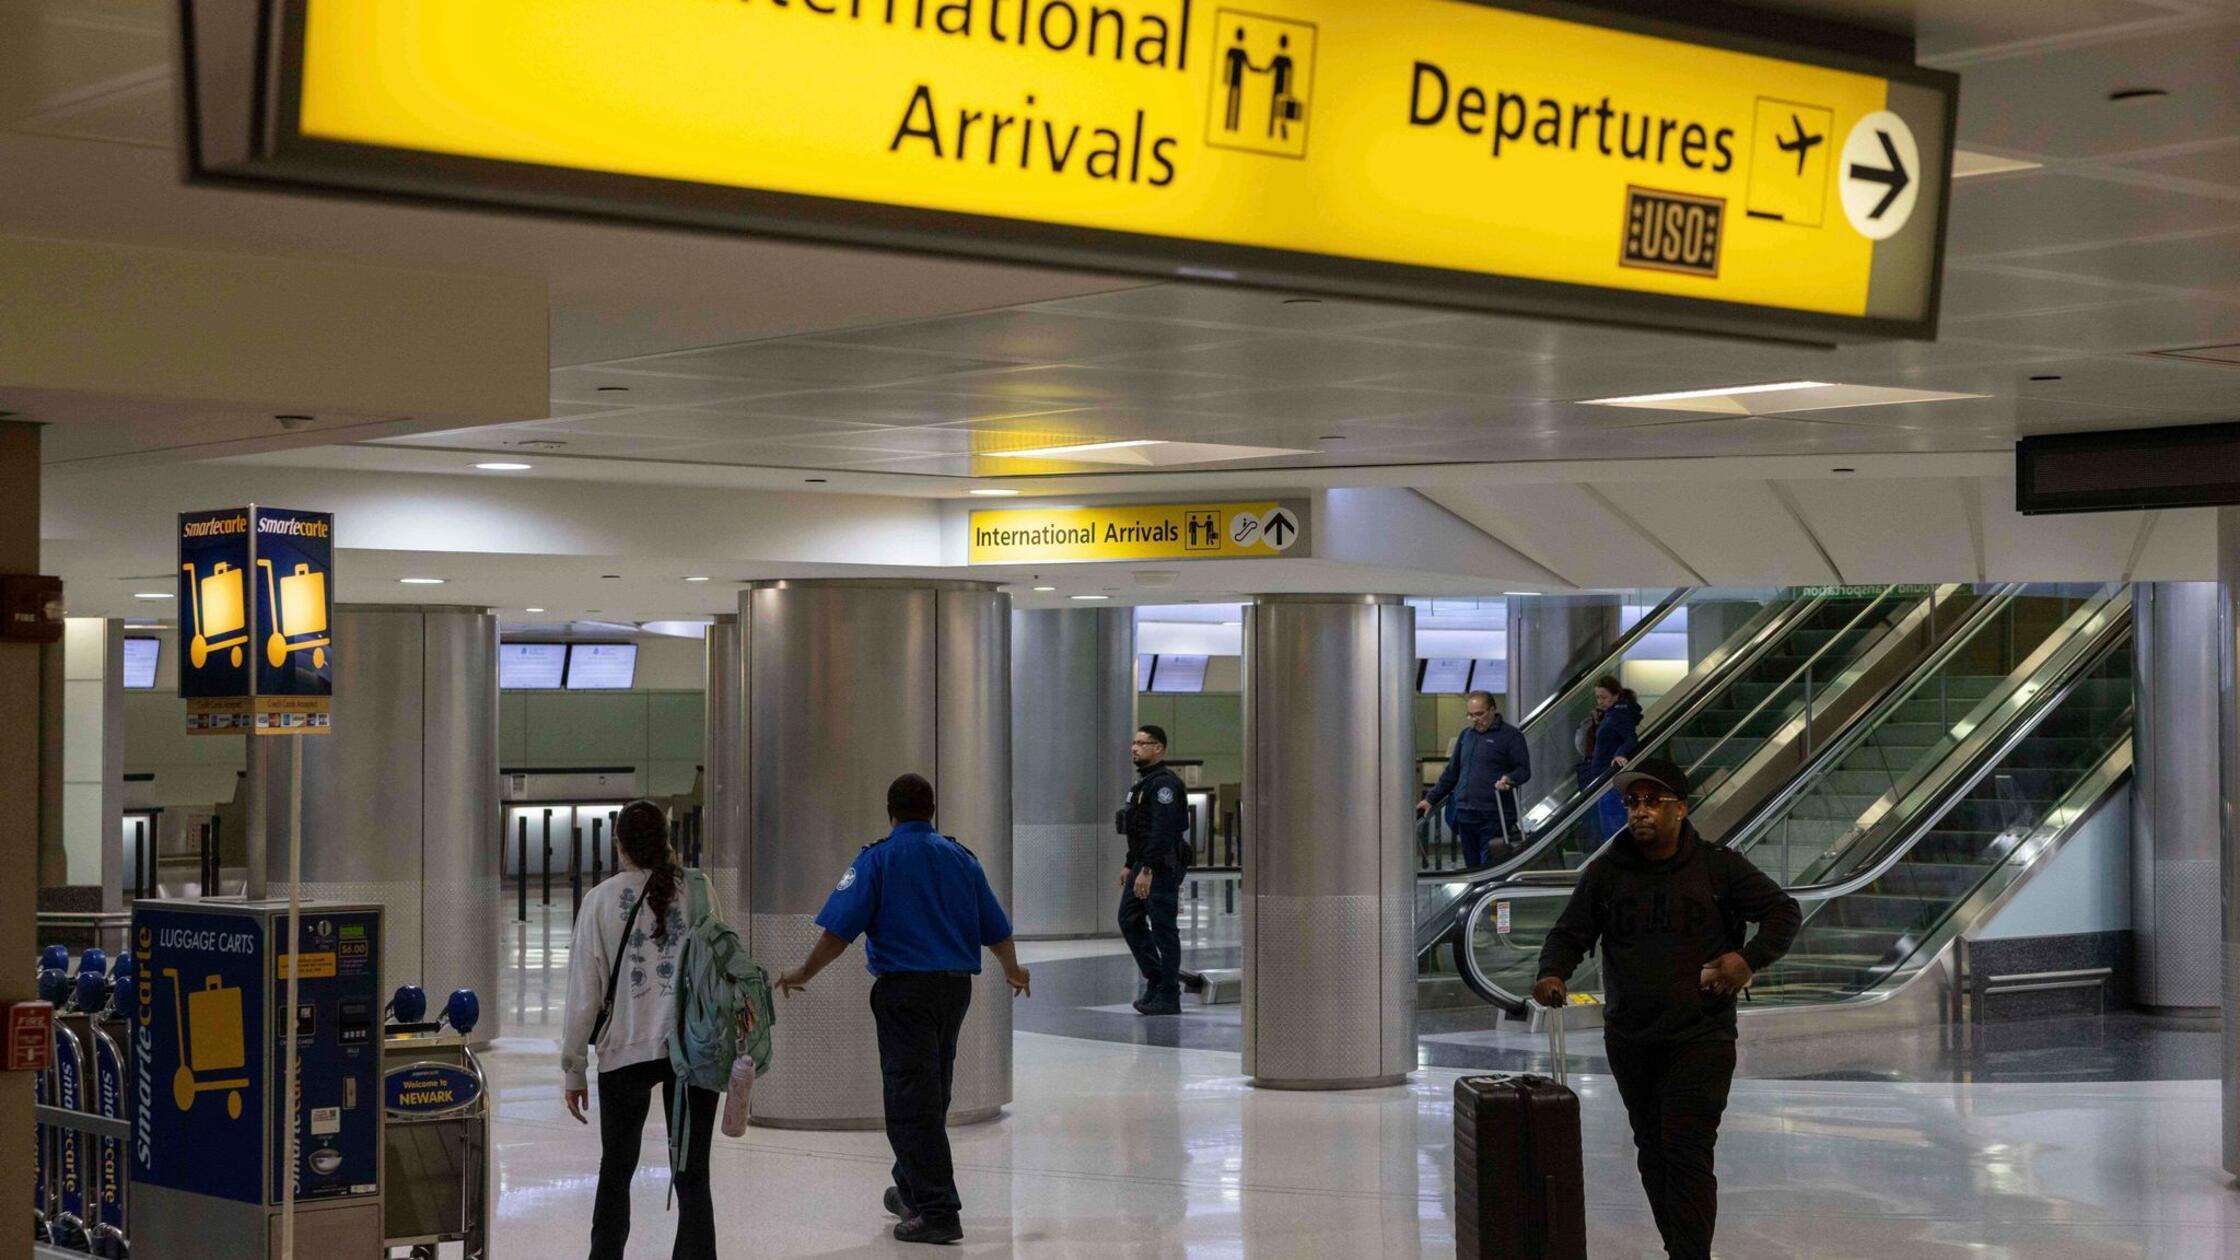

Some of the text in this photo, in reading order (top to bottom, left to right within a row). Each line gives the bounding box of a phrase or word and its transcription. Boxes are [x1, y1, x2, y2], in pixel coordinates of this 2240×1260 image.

[1408, 59, 1735, 174] Departures
[889, 84, 1178, 187] Arrivals
[1641, 199, 1705, 264] USO
[976, 519, 1179, 547] International Arrivals
[160, 927, 255, 954] LUGGAGE CARTS
[341, 943, 366, 954] $6.00
[17, 1016, 46, 1026] FIRE
[399, 1089, 454, 1106] NEWARK
[403, 1080, 438, 1089] Welcome
[62, 1061, 78, 1194] smaecarte
[102, 1069, 118, 1204] smaecarte
